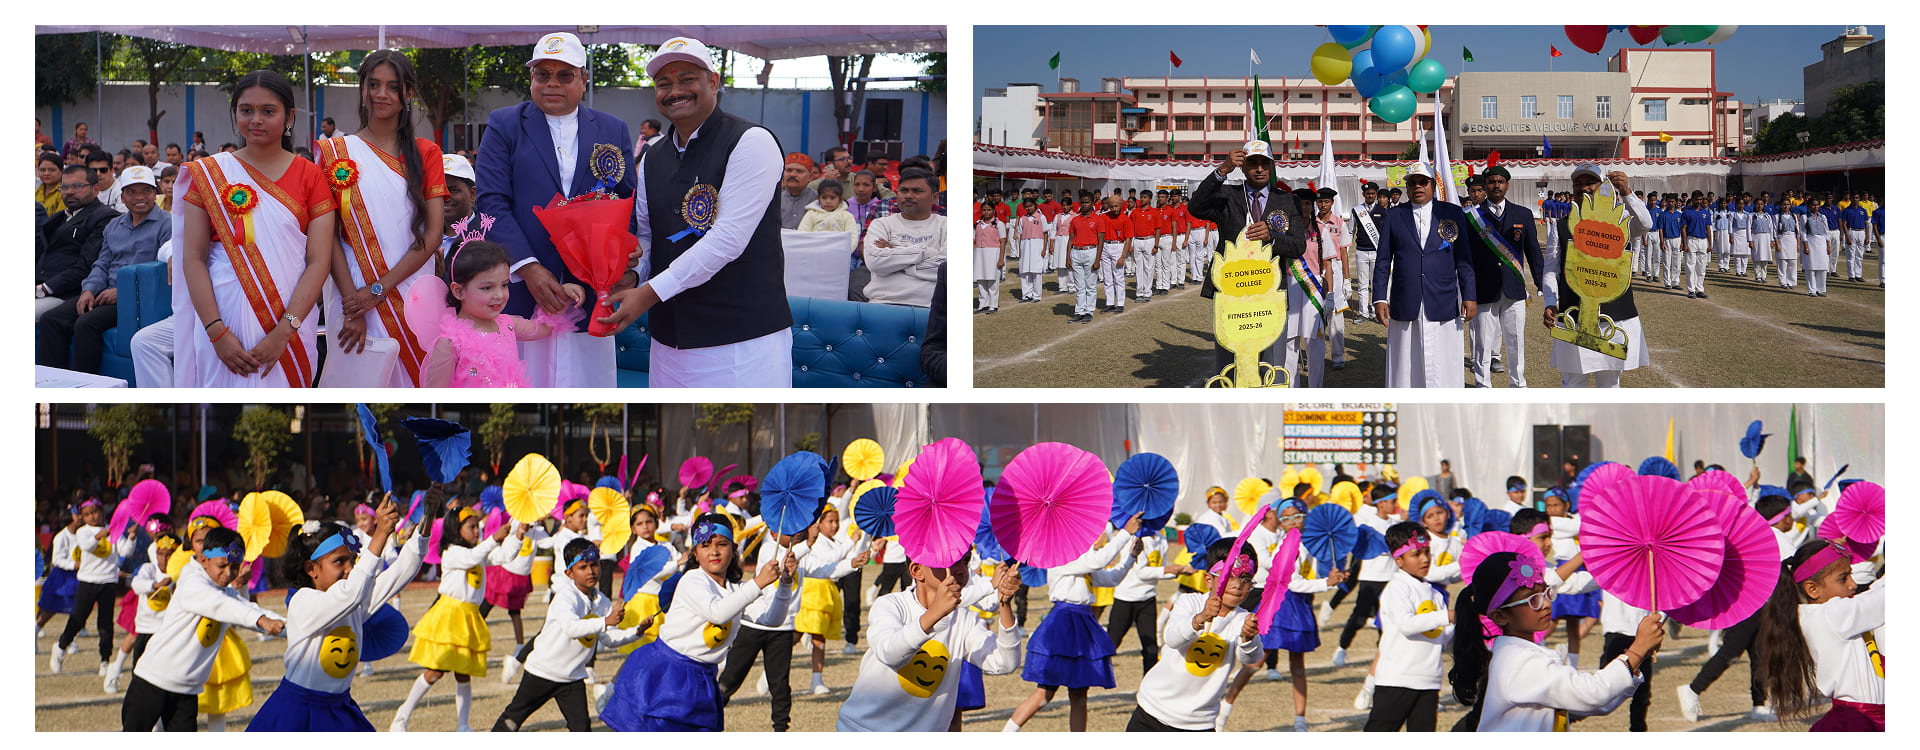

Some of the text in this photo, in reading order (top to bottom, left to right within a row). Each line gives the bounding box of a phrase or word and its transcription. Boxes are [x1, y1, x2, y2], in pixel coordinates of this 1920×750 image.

[1535, 122, 1579, 133] WELCOME
[1583, 123, 1600, 132] YOU
[1604, 123, 1619, 132] ALL
[1601, 233, 1620, 241] BOSCO
[1585, 241, 1610, 249] COLLEGE
[1577, 267, 1617, 279] FITNESS FIESTA
[1236, 280, 1262, 288] COLLEGE
[1585, 279, 1606, 288] 2025-26
[1227, 312, 1252, 320] FITNESS
[1331, 413, 1356, 421] HOUSE
[1333, 425, 1363, 436] HOUSE
[1316, 438, 1340, 449] BOSCO
[1333, 451, 1363, 462] HOUSE
